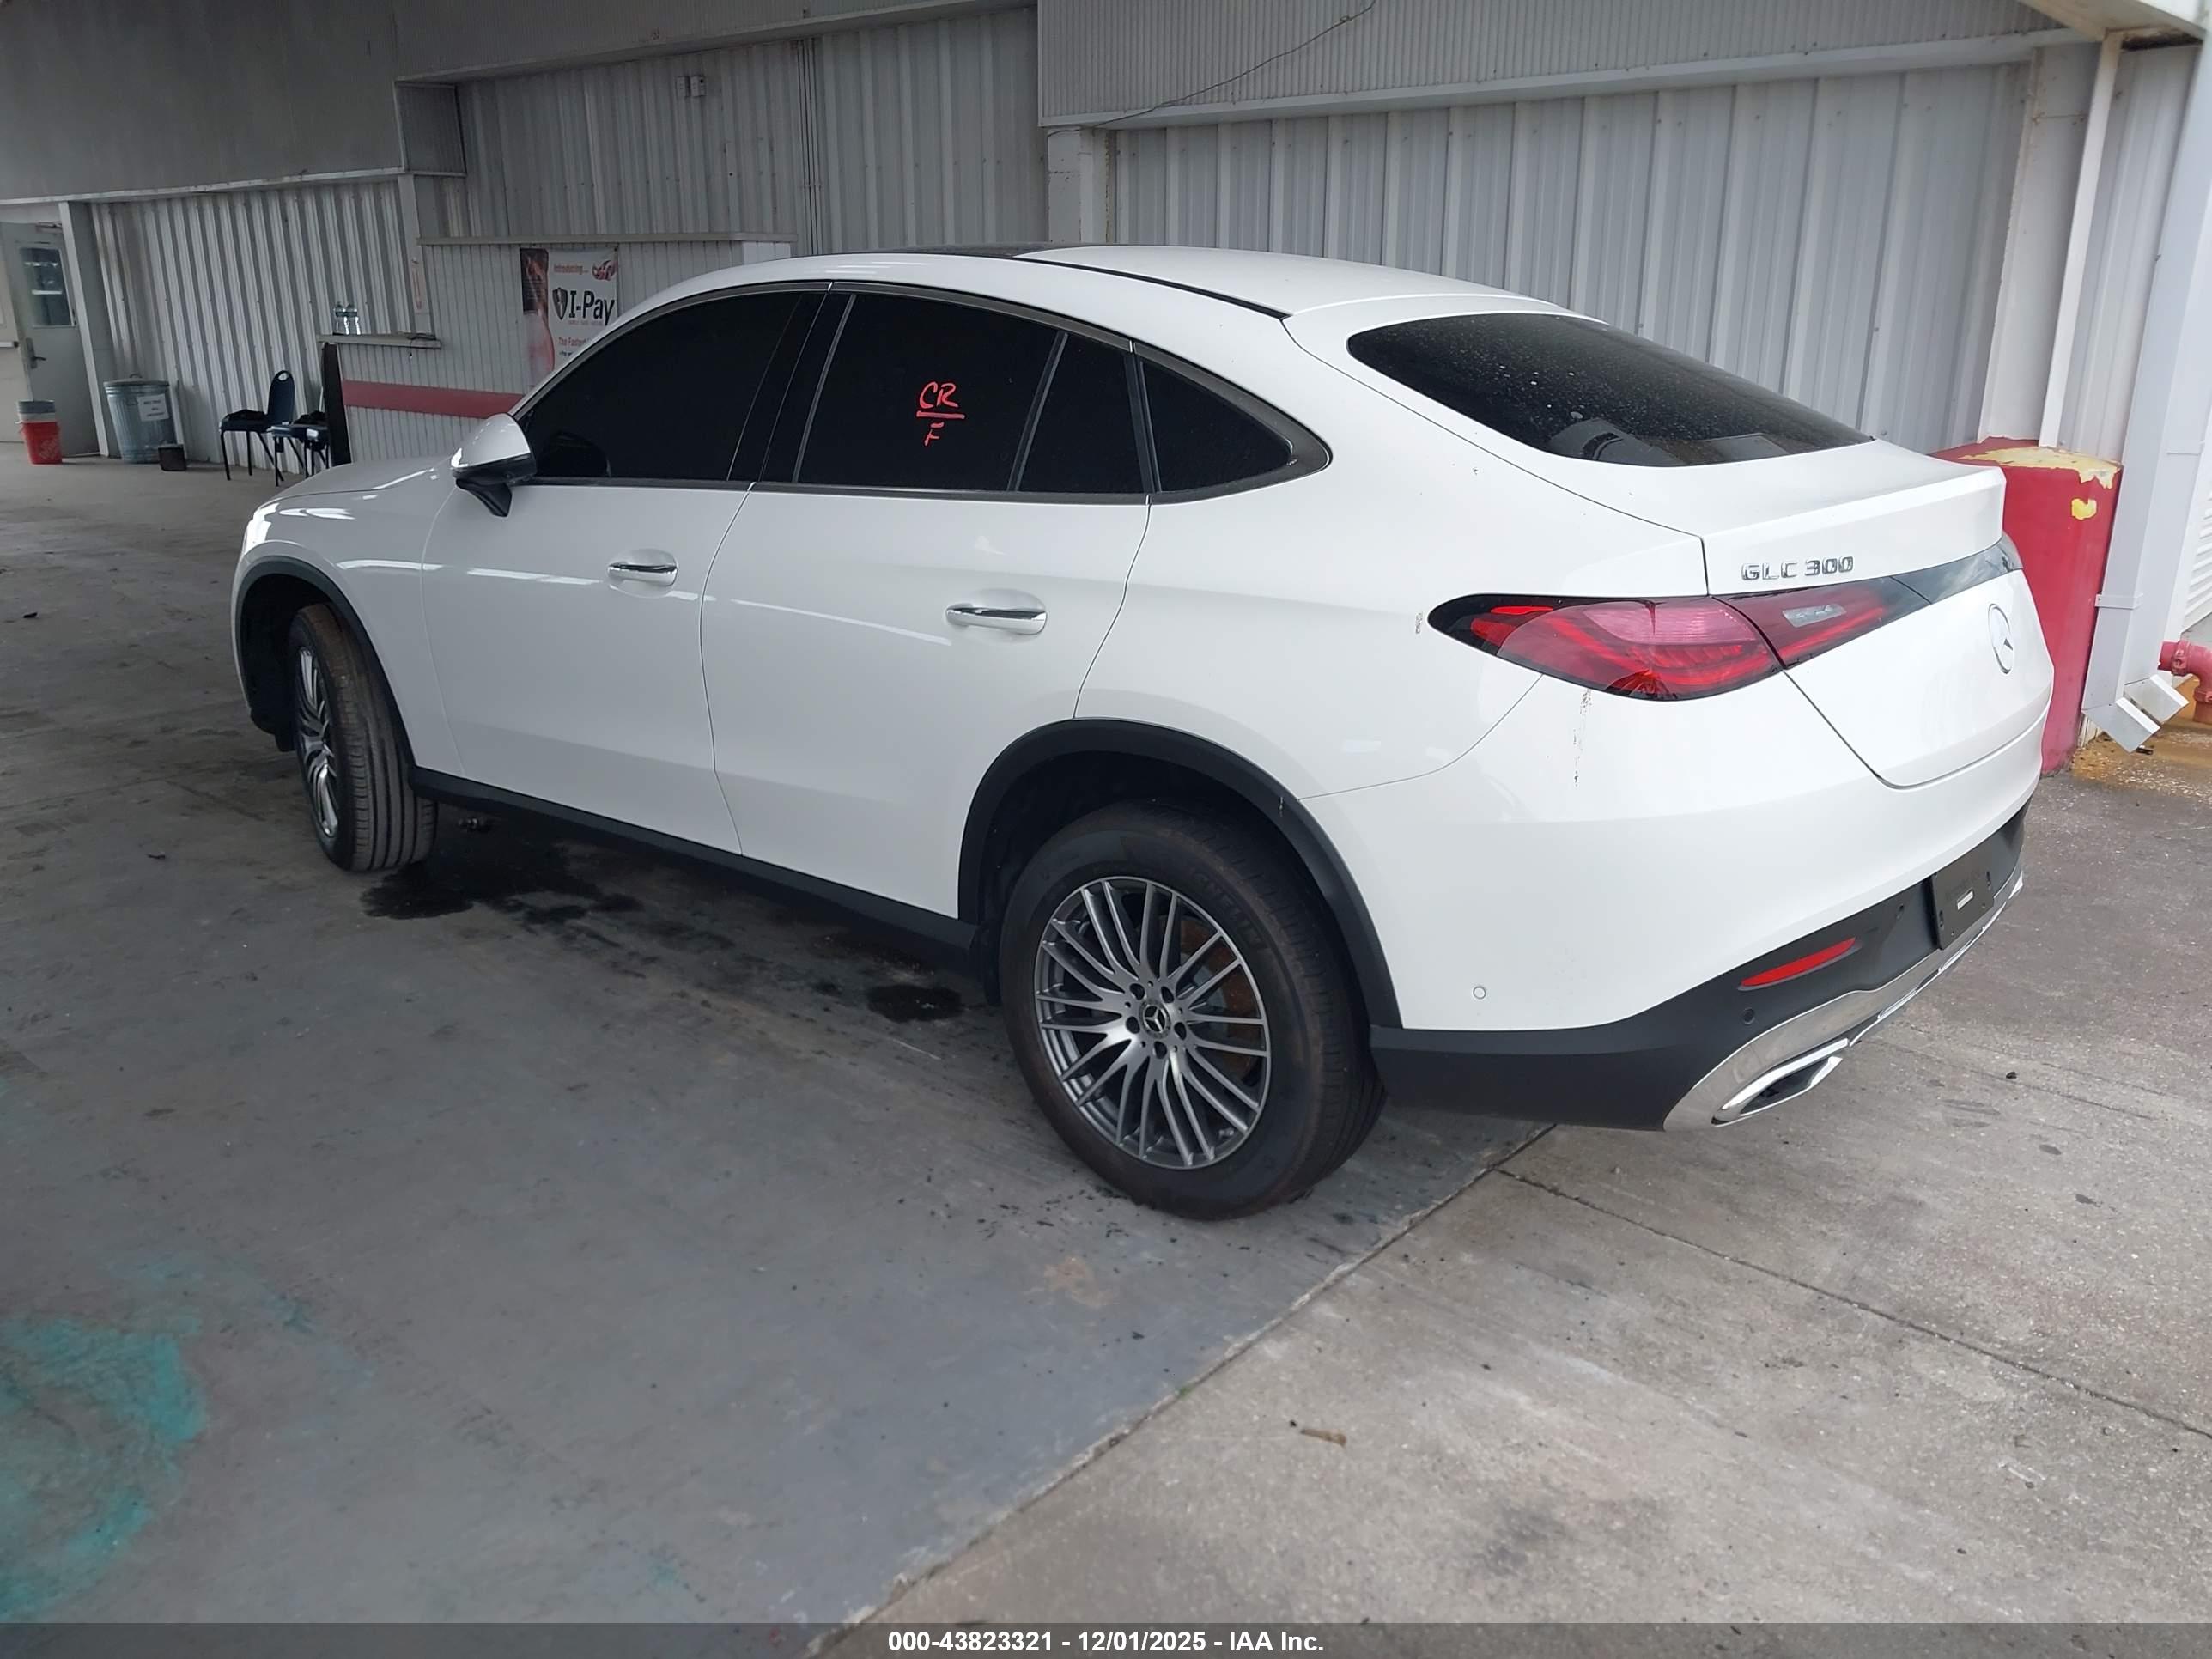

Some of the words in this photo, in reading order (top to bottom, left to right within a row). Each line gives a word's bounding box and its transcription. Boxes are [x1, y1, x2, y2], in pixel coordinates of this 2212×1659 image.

[568, 290, 615, 326] I-Pay
[919, 381, 959, 410] CR
[1741, 562, 1798, 581] GLC
[1804, 556, 1854, 577] 300
